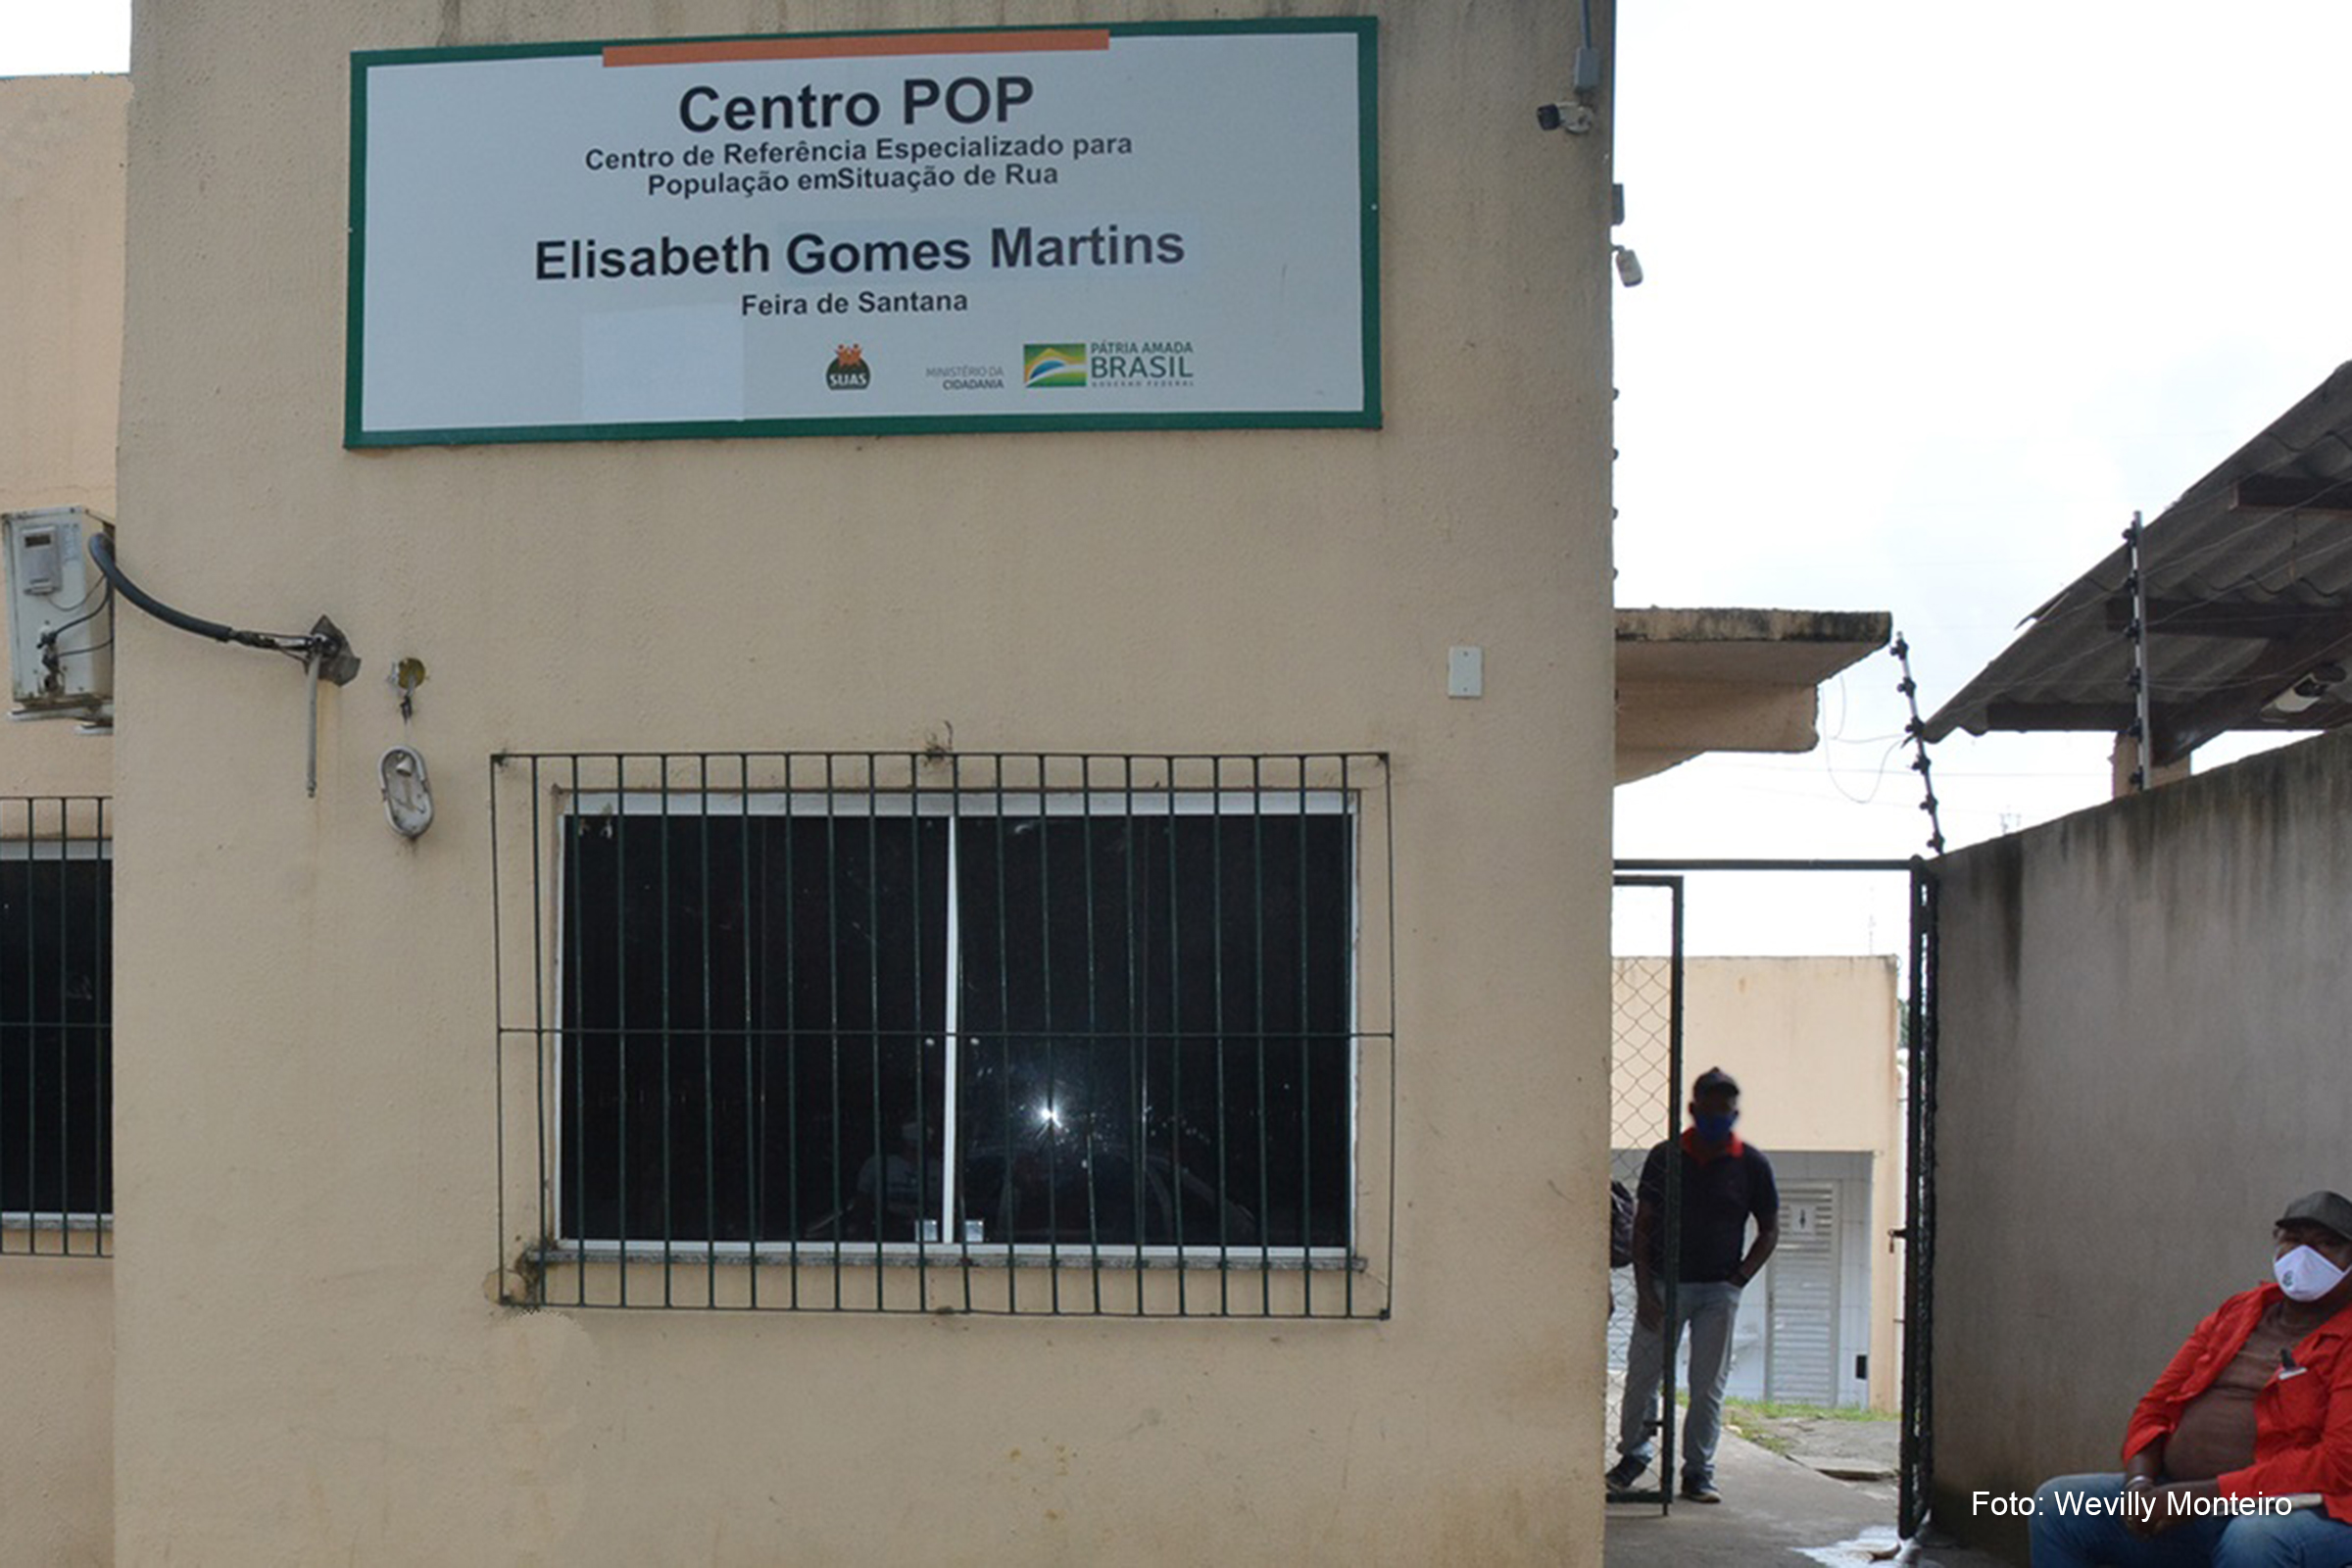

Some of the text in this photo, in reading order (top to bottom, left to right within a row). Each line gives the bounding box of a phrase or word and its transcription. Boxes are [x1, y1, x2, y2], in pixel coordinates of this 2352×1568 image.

[679, 75, 1034, 133] Centro POP
[585, 133, 1133, 171] Centro de Referência Especializado para
[648, 163, 1058, 198] População emSituação de Rua
[536, 223, 1185, 280] Elisabeth Gomes Martins
[742, 290, 968, 317] Feira de Santana
[1091, 340, 1194, 354] PÁTRIA AMADA
[829, 371, 867, 387] SUAS
[925, 366, 1004, 378] MINISTÉRIO DA
[1091, 355, 1194, 379] BRASIL
[942, 378, 1005, 391] CIDADANIA
